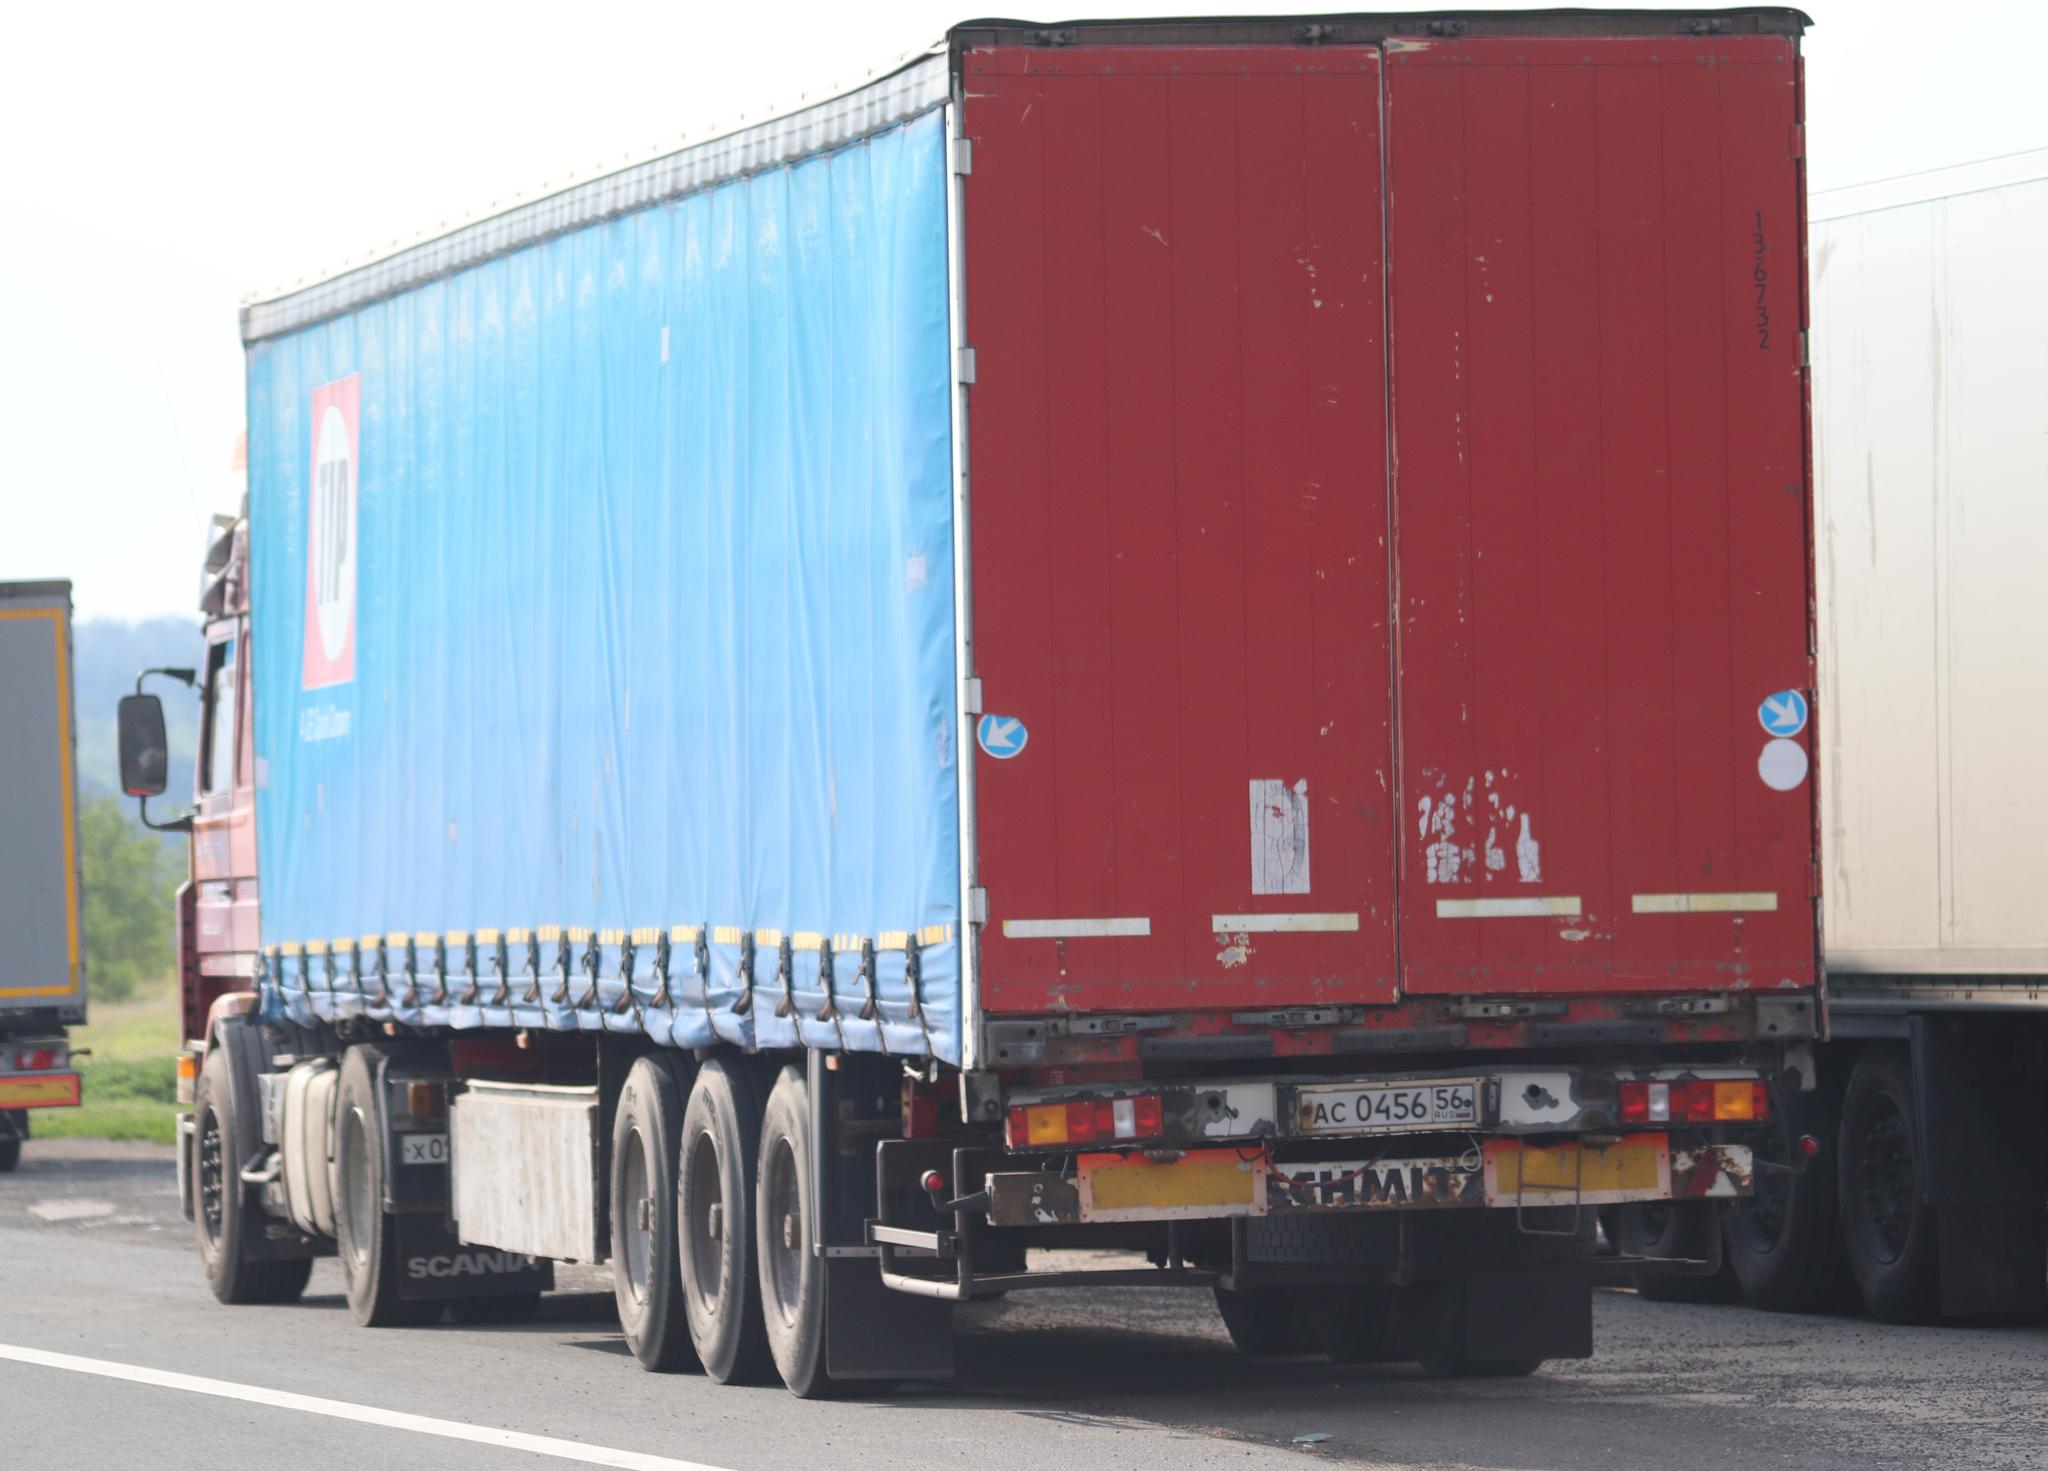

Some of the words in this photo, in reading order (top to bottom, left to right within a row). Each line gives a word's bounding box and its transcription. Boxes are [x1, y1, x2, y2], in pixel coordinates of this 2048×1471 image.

[318, 457, 349, 606] TIP
[1313, 1102, 1347, 1125] AC
[1355, 1091, 1427, 1122] 0456
[1435, 1088, 1463, 1110] 56
[1434, 1110, 1455, 1120] RUS
[407, 1252, 541, 1279] SCANIA
